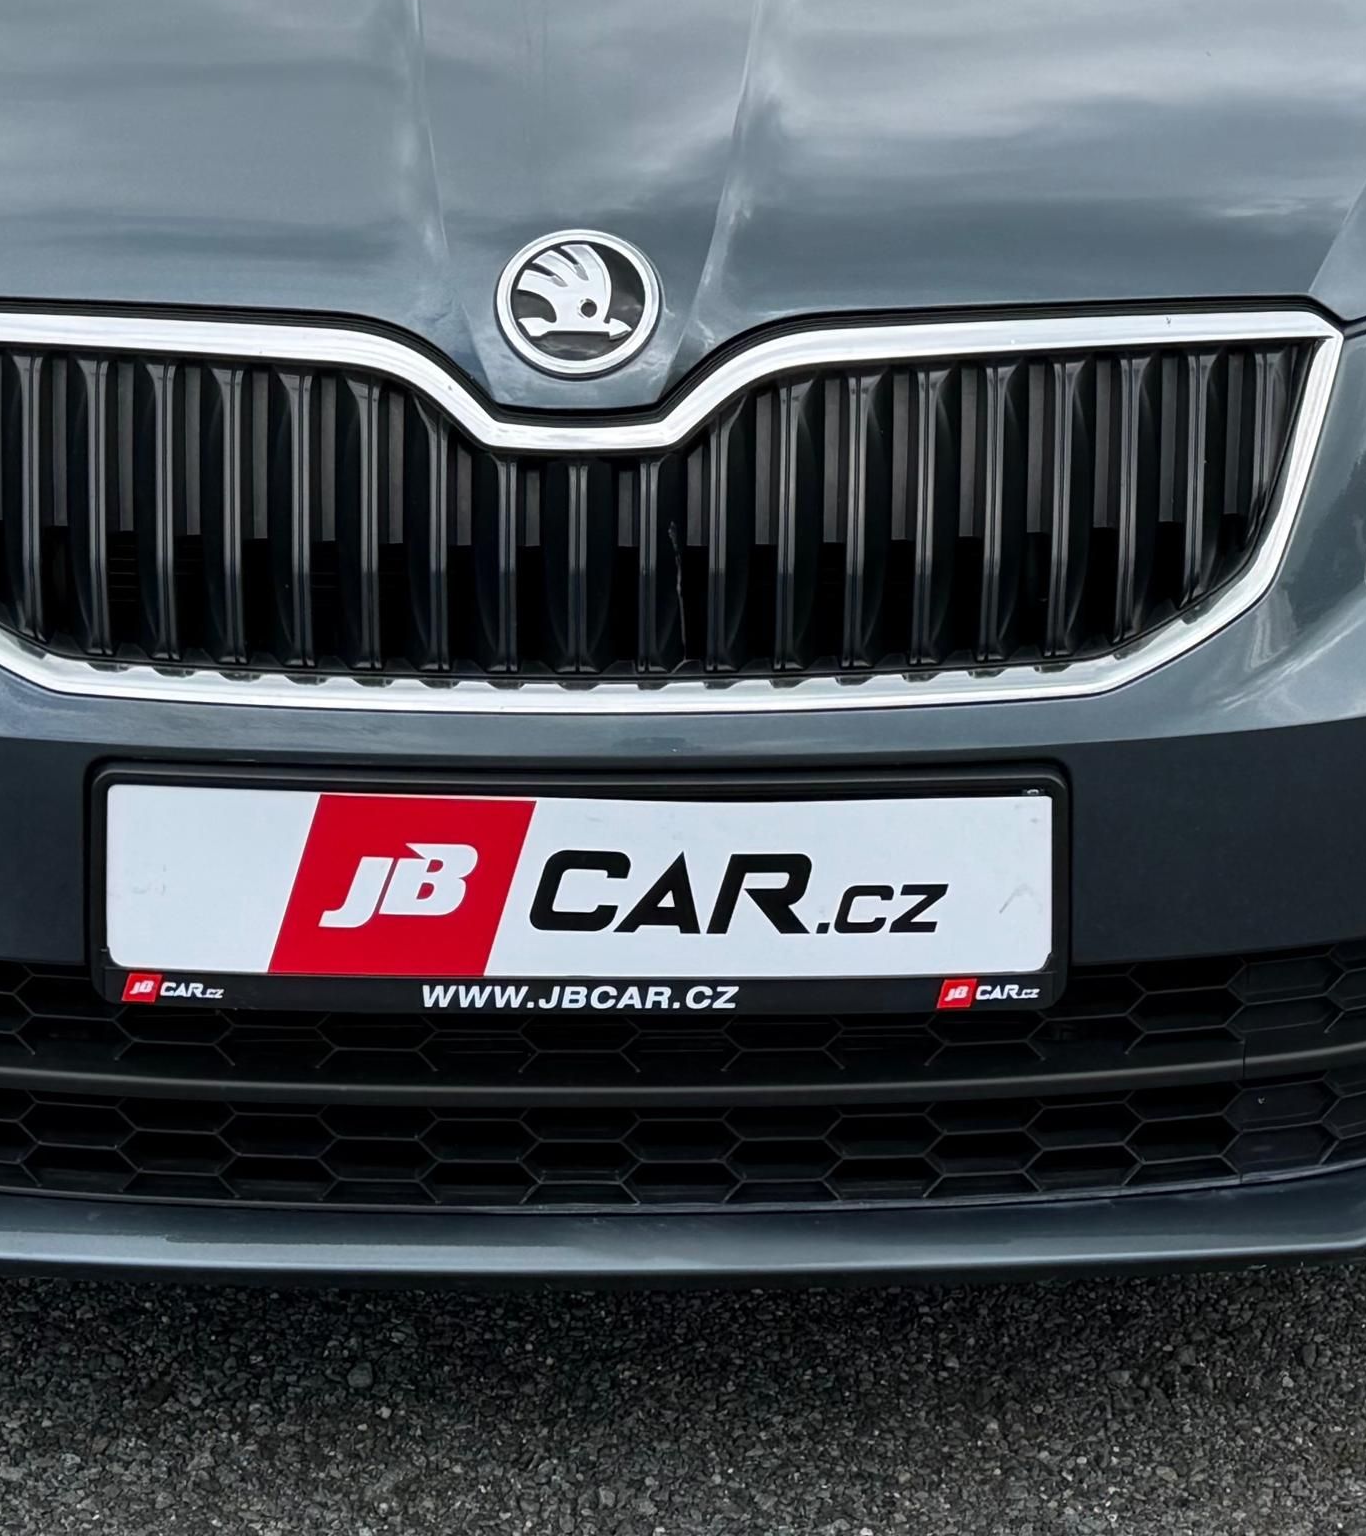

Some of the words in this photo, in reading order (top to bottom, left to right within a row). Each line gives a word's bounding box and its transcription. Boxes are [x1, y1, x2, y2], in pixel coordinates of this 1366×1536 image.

[317, 842, 479, 929] JB
[129, 980, 155, 995] JB
[421, 984, 740, 1010] WWW.JBCAR.CZ
[943, 985, 970, 1002] JB
